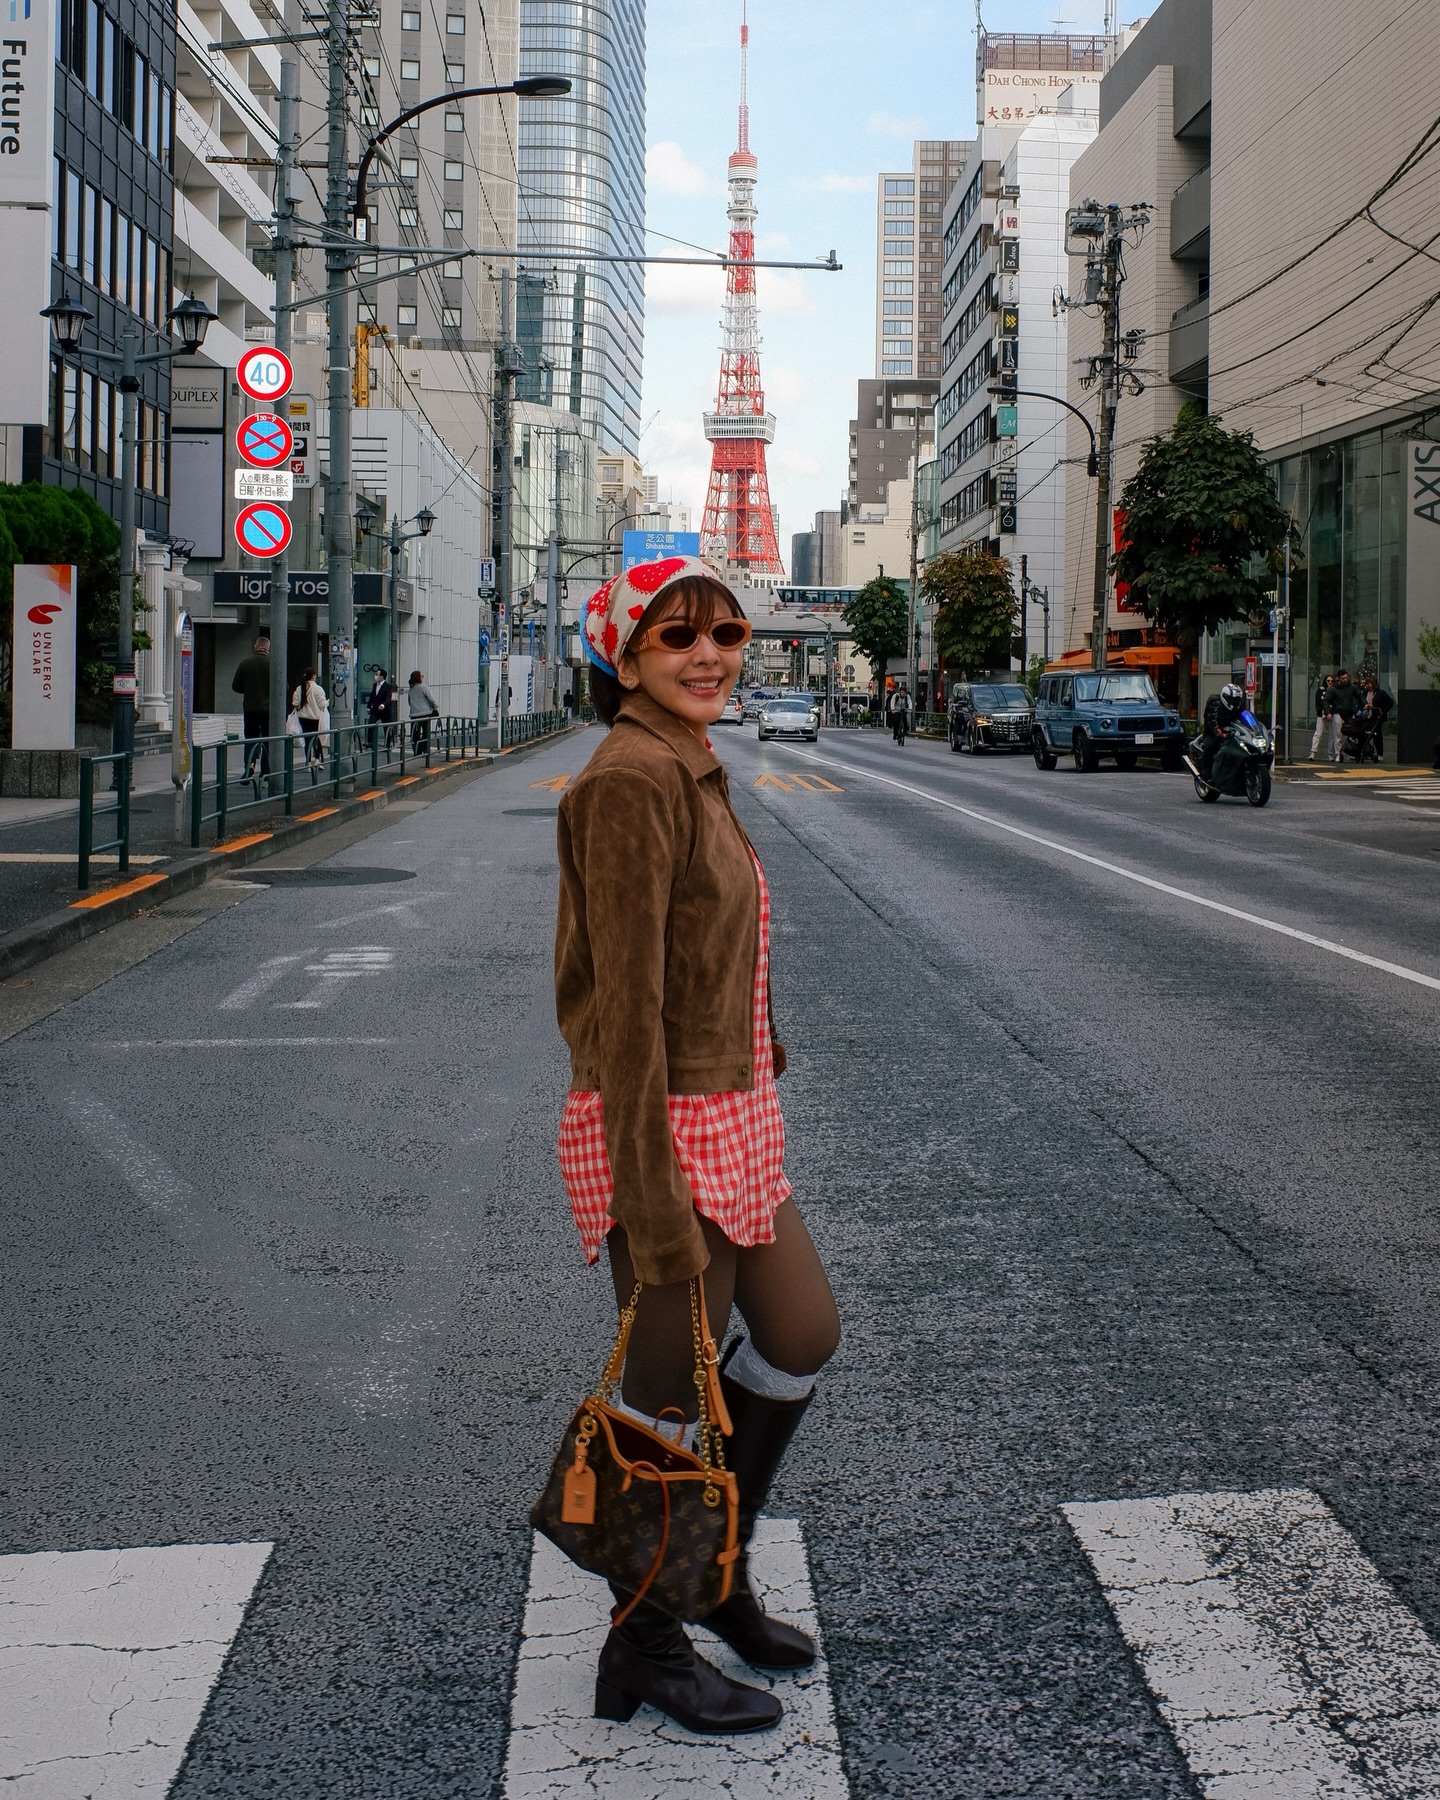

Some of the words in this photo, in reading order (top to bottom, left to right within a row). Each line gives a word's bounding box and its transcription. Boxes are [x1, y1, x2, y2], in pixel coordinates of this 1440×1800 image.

[988, 74, 1010, 86] DAH
[1013, 75, 1046, 87] CHONG
[1, 40, 27, 155] Future
[249, 361, 280, 387] 40
[239, 473, 289, 485] 人の乗降を除く
[1414, 445, 1440, 525] AXIS
[646, 533, 675, 544] 芝公園
[32, 632, 41, 675] SOLAR
[43, 632, 52, 700] UNIVERGY
[528, 774, 573, 793] 4
[754, 773, 845, 793] 40
